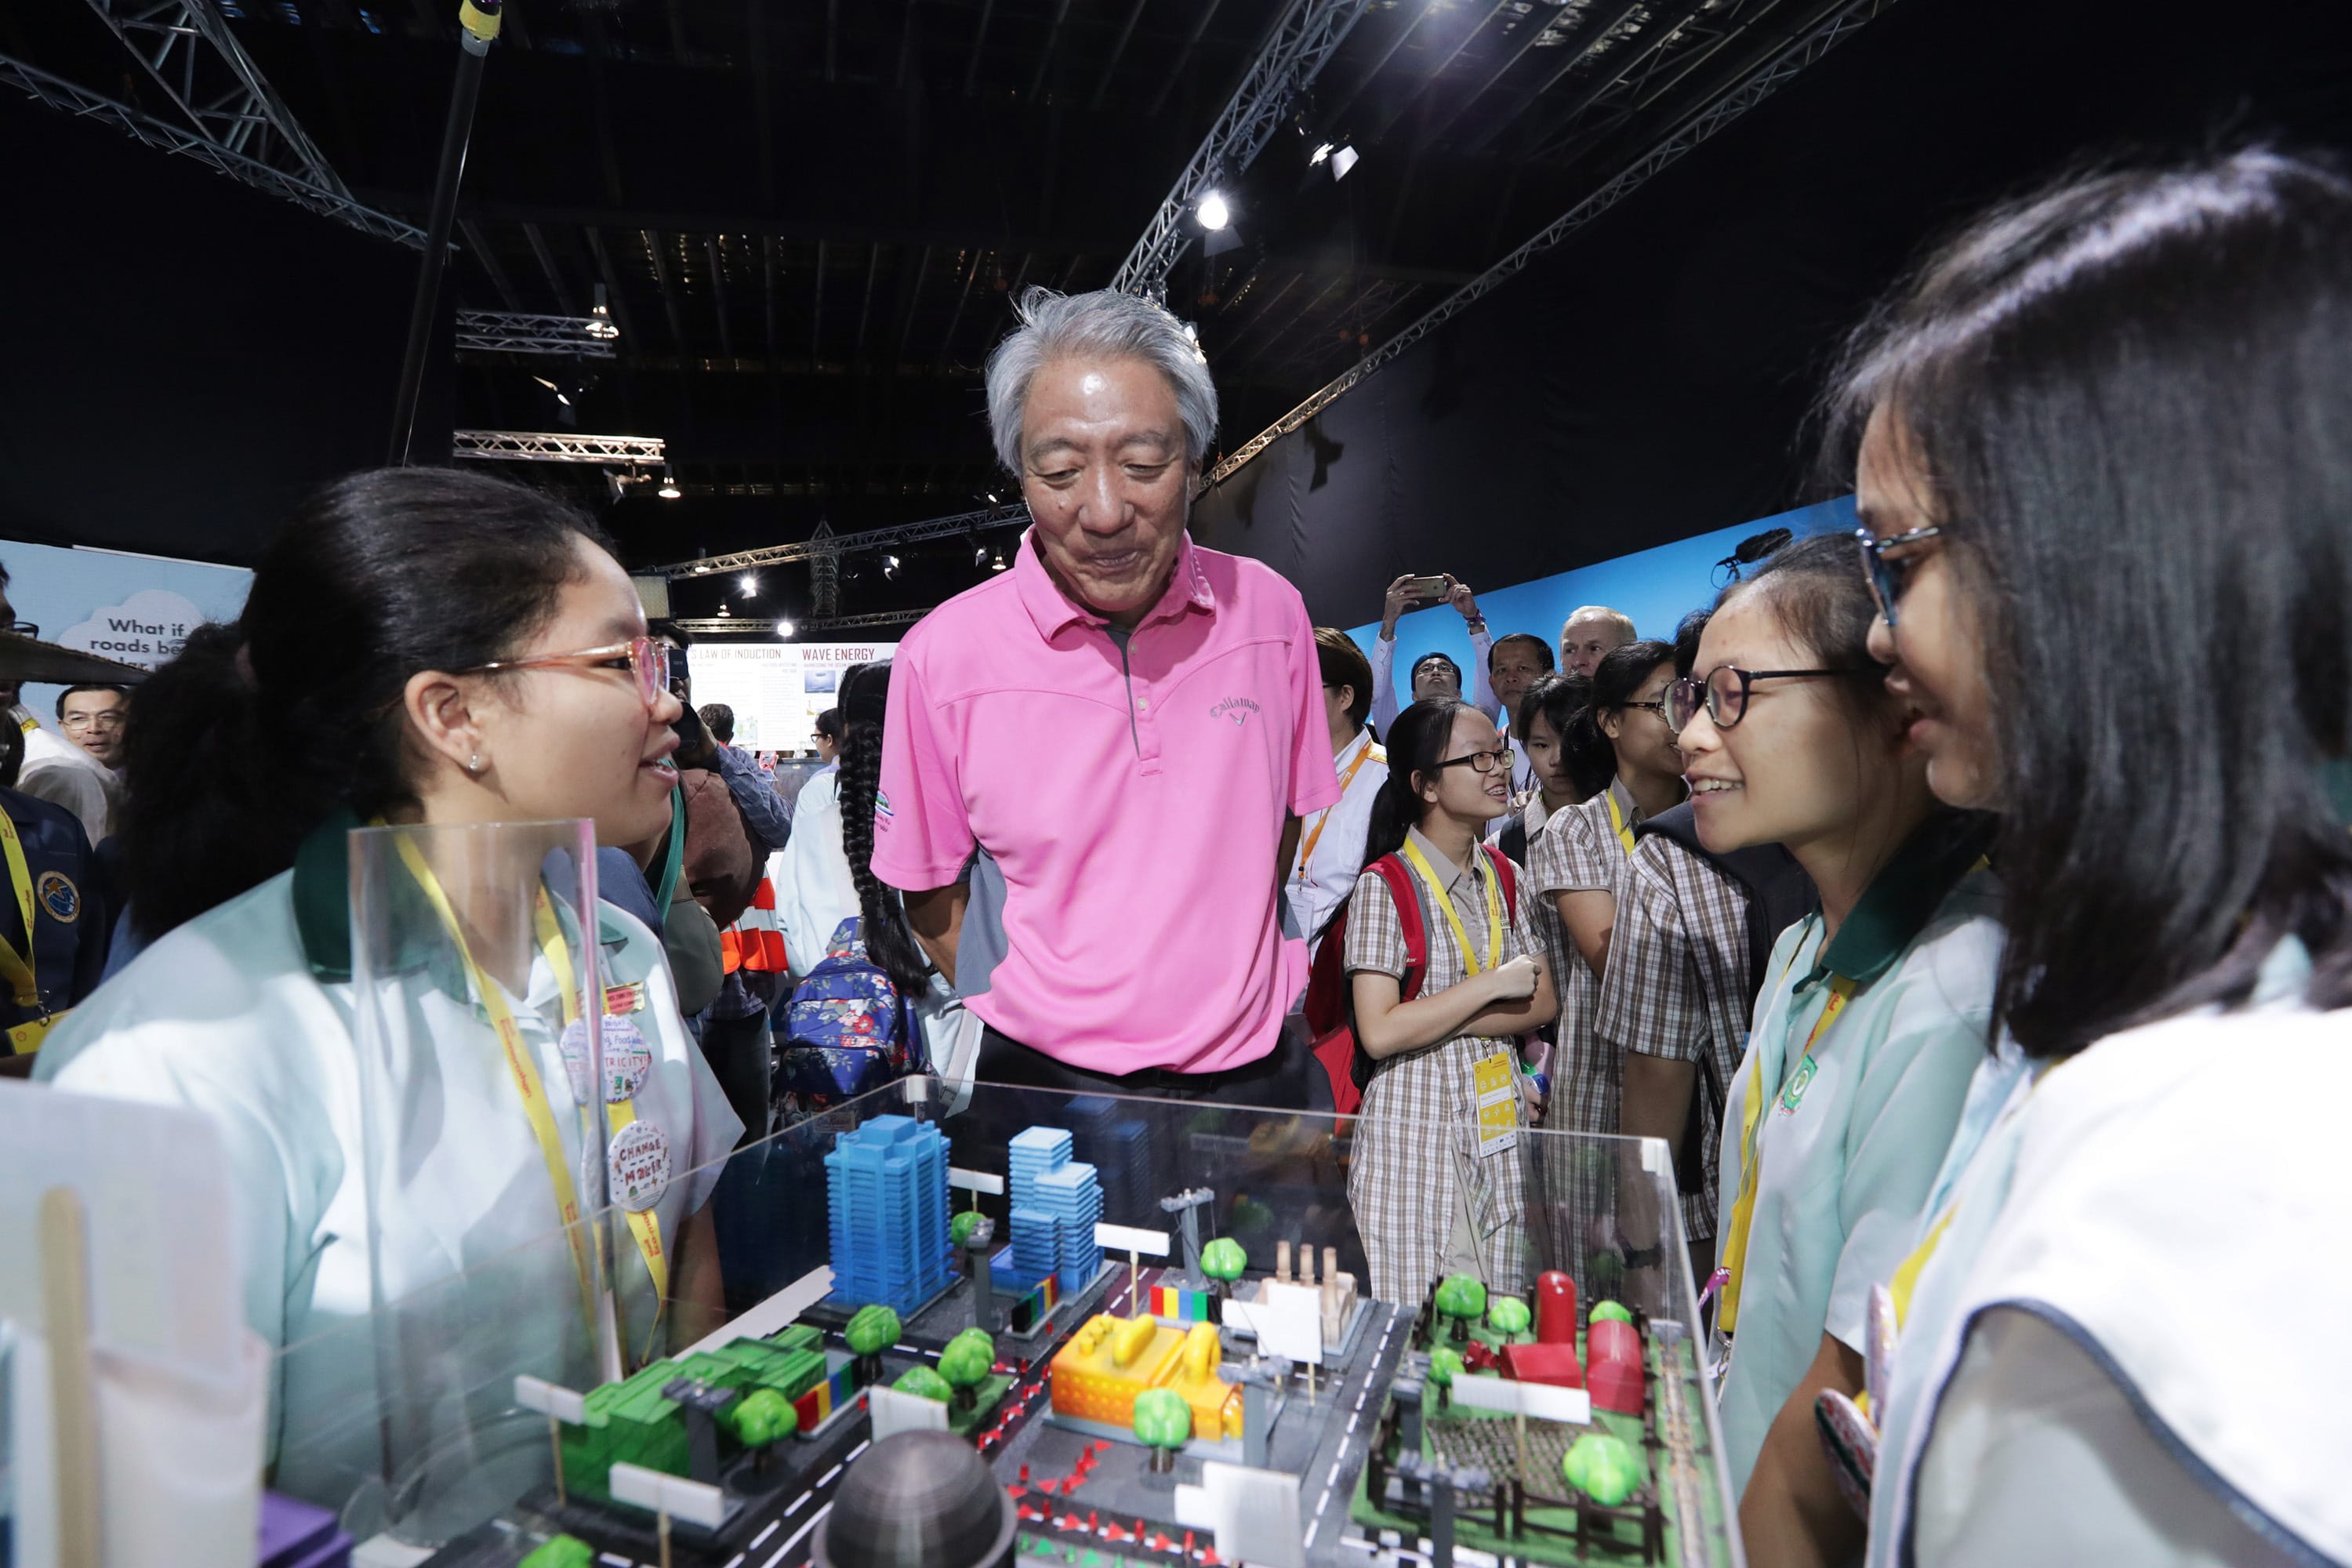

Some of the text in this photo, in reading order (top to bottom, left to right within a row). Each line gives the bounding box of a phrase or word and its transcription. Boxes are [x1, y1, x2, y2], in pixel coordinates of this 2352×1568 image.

[108, 618, 184, 637] What if
[90, 639, 183, 655] roads be
[700, 649, 717, 659] LAW
[720, 649, 733, 659] OF
[735, 648, 781, 659] INDUCTION
[802, 648, 875, 661] WAVE ENERGY
[1210, 696, 1260, 719] Callaway
[619, 1138, 661, 1161] CHANGE
